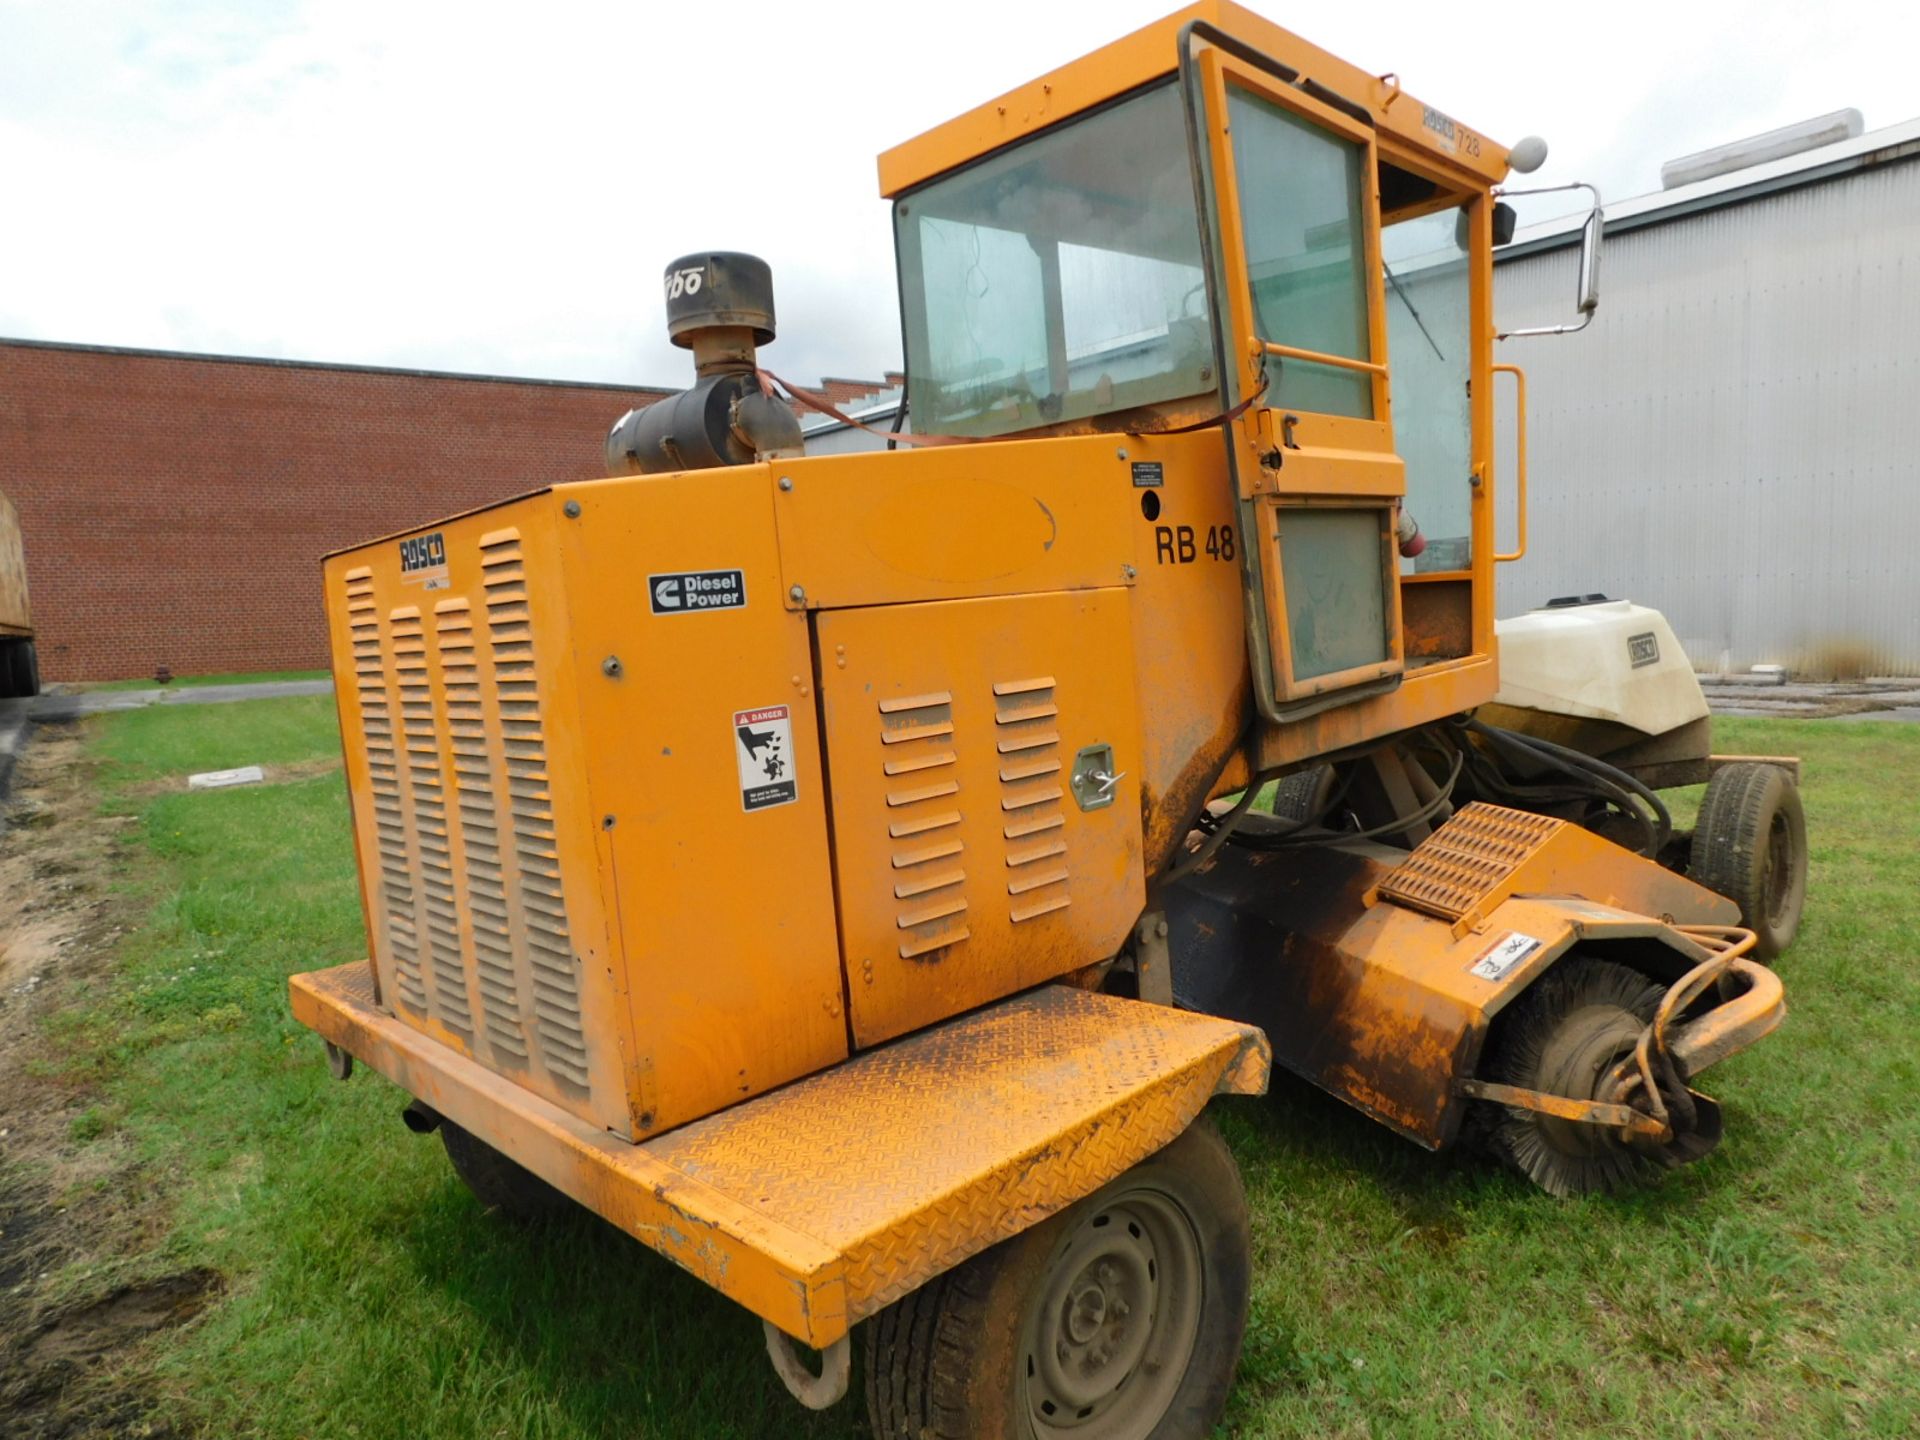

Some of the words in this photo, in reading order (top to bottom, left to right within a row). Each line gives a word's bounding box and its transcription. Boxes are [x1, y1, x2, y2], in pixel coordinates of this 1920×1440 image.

[1457, 128, 1480, 158] 728
[399, 532, 446, 572] ROSCO
[1155, 525, 1196, 565] RB
[1205, 524, 1235, 562] 48
[684, 573, 737, 592] Diesel
[686, 591, 739, 608] Power
[751, 709, 783, 722] DANGER
